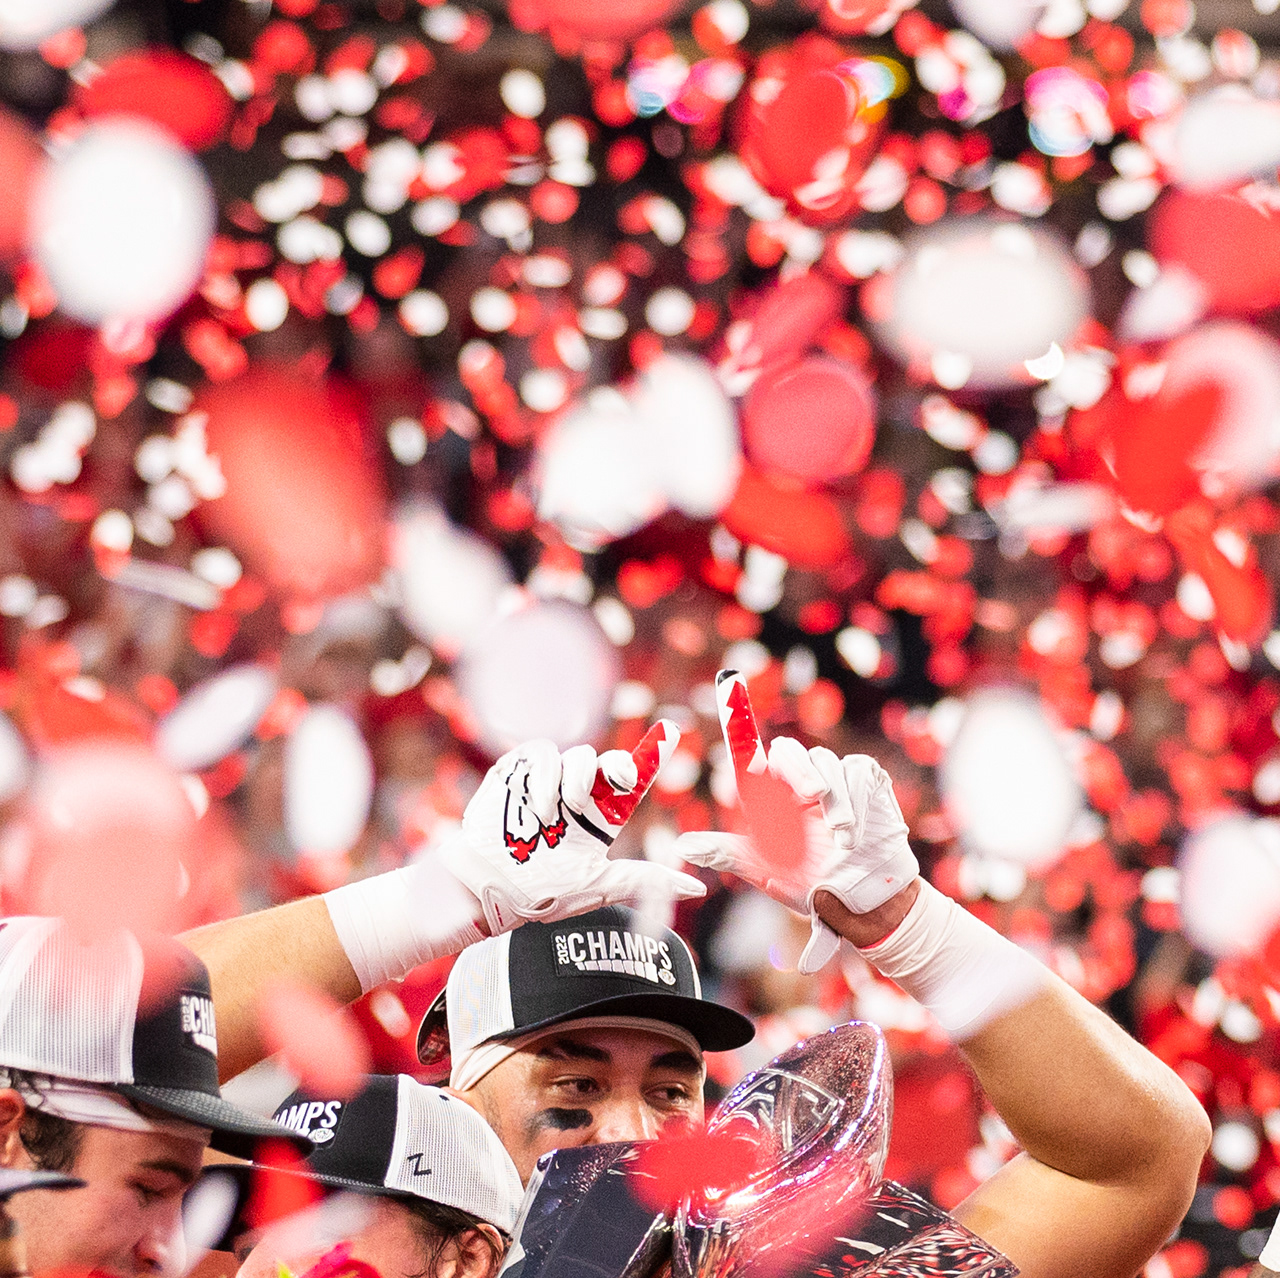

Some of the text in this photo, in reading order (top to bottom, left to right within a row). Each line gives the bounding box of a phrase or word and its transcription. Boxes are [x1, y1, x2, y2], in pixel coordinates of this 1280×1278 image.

[555, 931, 673, 971] 2022 CHAMPS
[273, 1100, 342, 1131] AMPS
